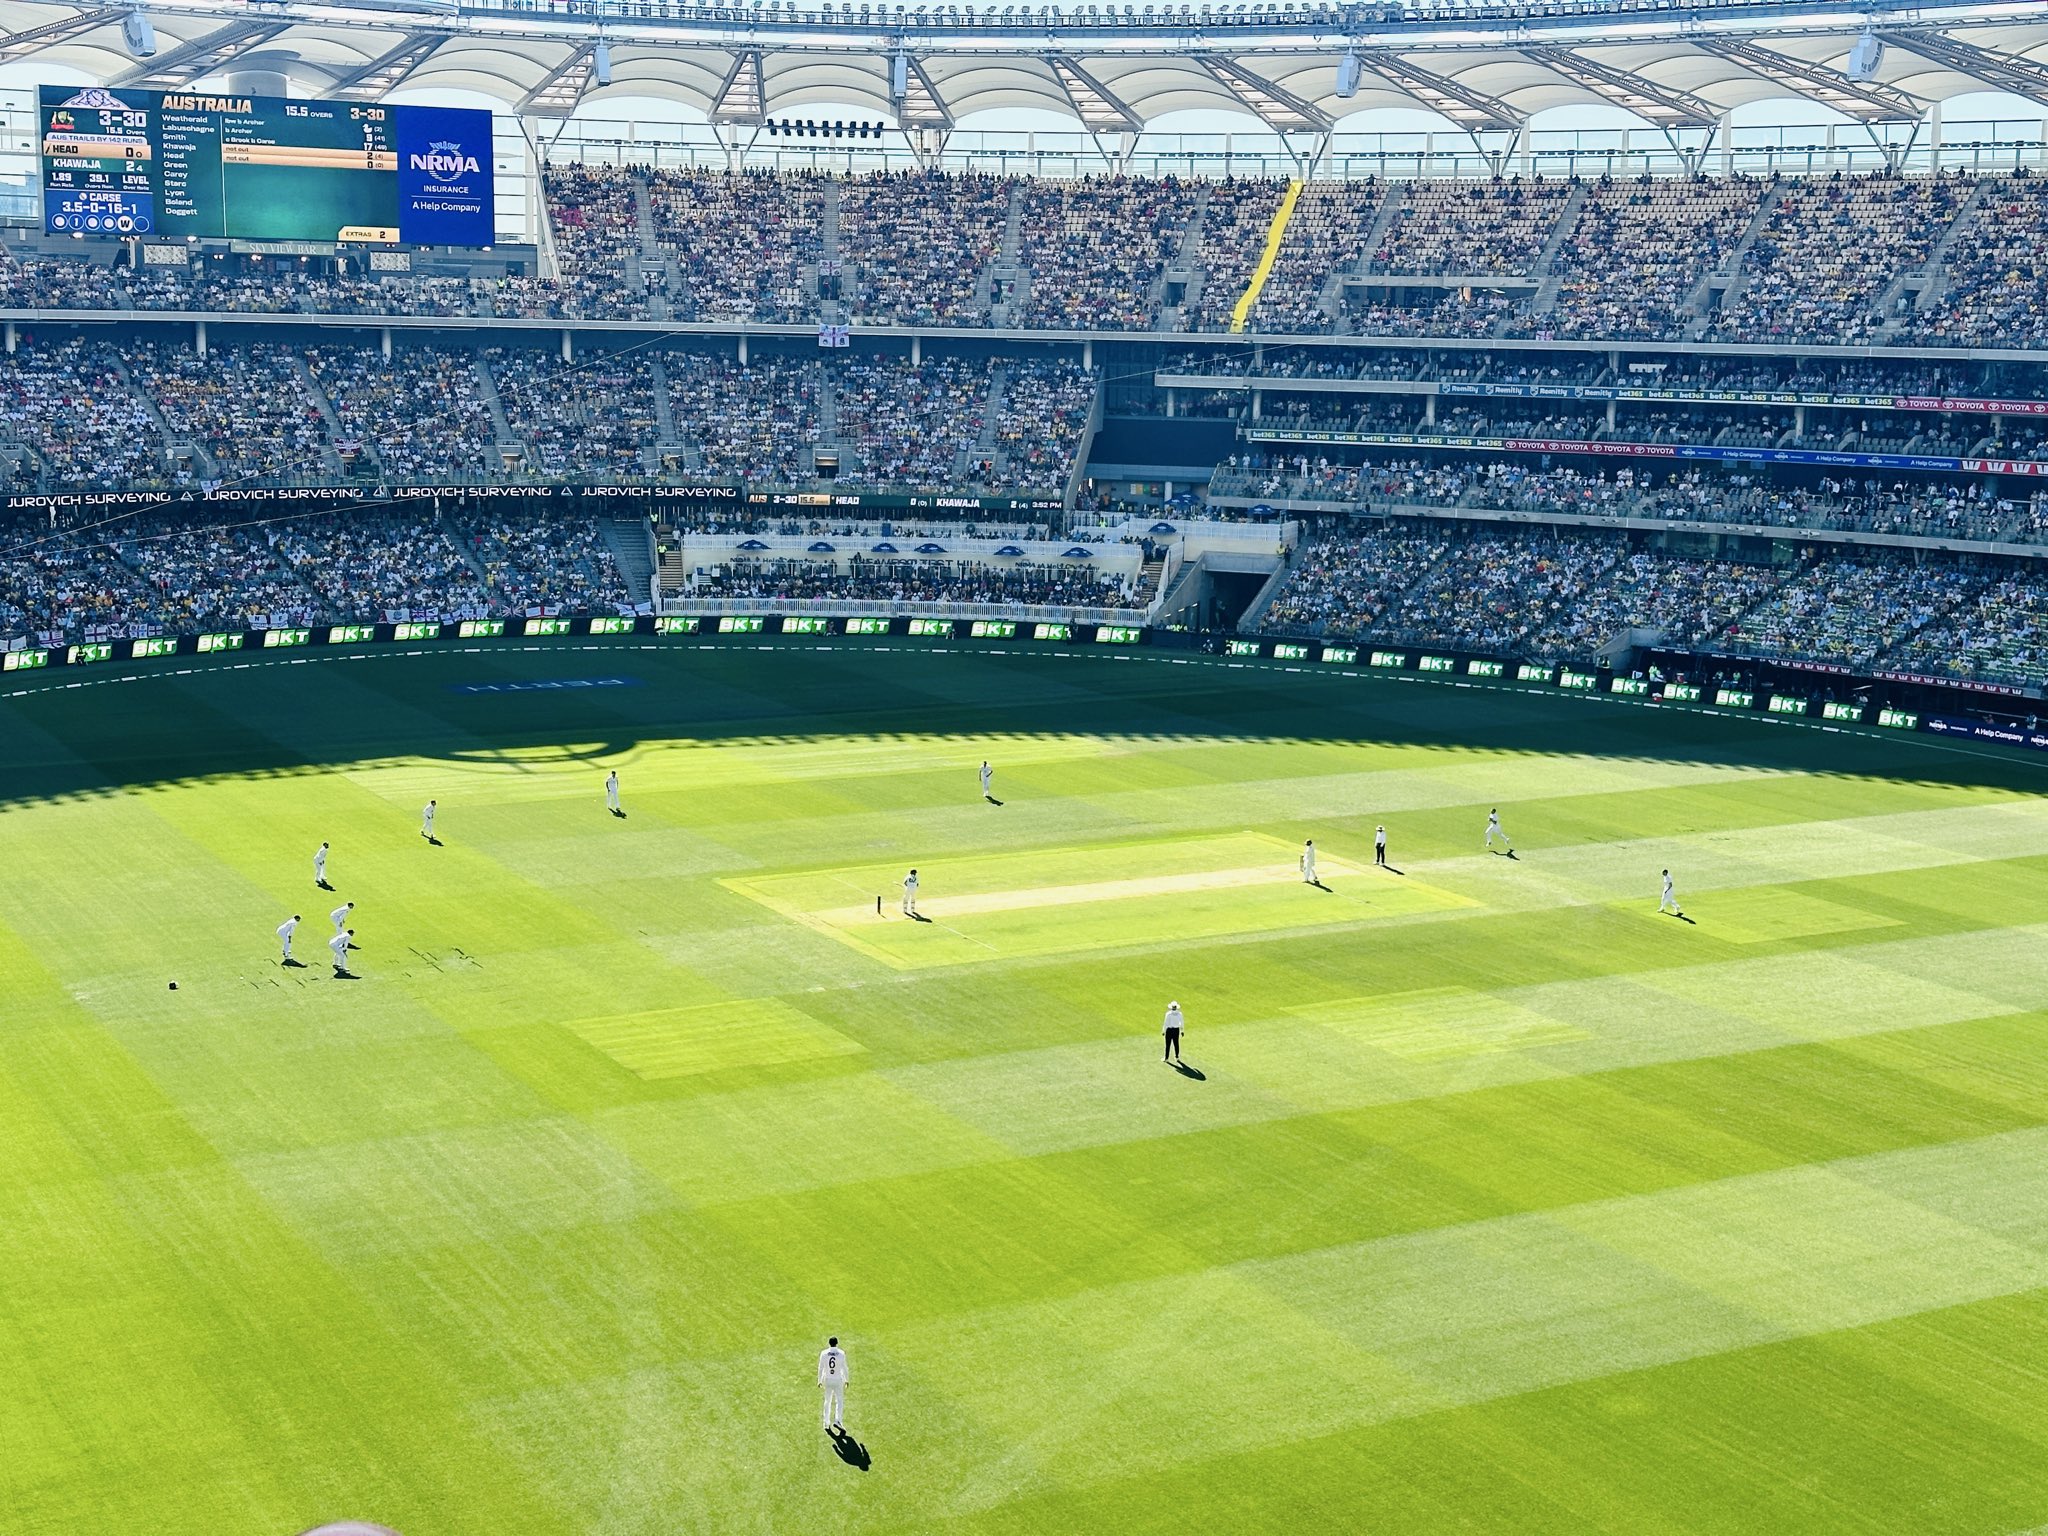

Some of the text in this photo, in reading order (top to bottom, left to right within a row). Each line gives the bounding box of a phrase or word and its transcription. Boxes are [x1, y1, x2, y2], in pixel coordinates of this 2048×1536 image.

[161, 95, 253, 114] AUSTRALIA
[285, 105, 308, 117] 15.5
[350, 107, 385, 121] 3-30
[99, 110, 147, 127] 3-30
[161, 114, 208, 123] Weatherald
[105, 126, 123, 134] 15.5
[162, 124, 215, 133] Labuschagne
[162, 133, 187, 141] Smith
[52, 144, 78, 154] HEAD
[126, 147, 134, 157] 0
[162, 142, 197, 151] Khawaja
[363, 142, 373, 150] 17
[163, 151, 185, 159] Head
[367, 152, 373, 160] 2
[53, 158, 102, 169] KHAWAJA
[126, 160, 134, 172] 2
[163, 161, 188, 169] Green
[410, 154, 480, 173] NRMA
[52, 172, 149, 185] 1.89 39.1 LEVEL
[164, 170, 188, 179] Carey
[164, 179, 187, 187] Starc
[423, 184, 469, 194] INSURANCE
[89, 192, 121, 203] CARSE
[165, 189, 185, 197] Lyon
[165, 198, 193, 206] Boland
[412, 201, 481, 213] A Help Company
[165, 207, 198, 216] Doggett
[120, 219, 130, 228] W
[379, 230, 386, 239] 2
[249, 243, 317, 254] SKY VIEW BAR
[1451, 385, 1479, 394] Remitly
[1495, 386, 1523, 395] Remitly
[1539, 387, 1568, 397] Remitly
[1584, 388, 1612, 398] Remitly
[1909, 400, 1938, 408] TOYOTA
[1955, 402, 1984, 410] TOYOTA
[2000, 403, 2030, 412] TOYOTA
[1517, 441, 1545, 449] TOYOTA
[1560, 443, 1588, 451] TOYOTA
[1603, 445, 1631, 453] TOYOTA
[1646, 447, 1675, 455] TOYOTA
[1739, 451, 1763, 459] Company
[1928, 460, 1953, 468] Company
[203, 488, 364, 501] JUROVICH SURVEYING
[393, 486, 552, 498] JUROVICH SURVEYING
[581, 486, 736, 498] JUROVICH SURVEYING
[7, 492, 171, 508] JUROVICH SURVEYING
[749, 495, 768, 503] AUS
[773, 495, 798, 504] 3-30
[800, 496, 815, 504] 15.5
[835, 496, 860, 505] HEAD
[936, 497, 1028, 510] KHAWAJA 2 (4)
[459, 620, 504, 638] BKT
[524, 618, 570, 636] BKT
[590, 617, 636, 634] BKT
[718, 617, 764, 633] BKT
[845, 618, 890, 634] BKT
[908, 619, 953, 635] BKT
[971, 621, 1016, 637] BKT
[329, 626, 375, 644] BKT
[394, 623, 440, 640] BKT
[1096, 626, 1142, 643] BKT
[197, 632, 244, 652] BKT
[264, 629, 310, 648] BKT
[132, 637, 178, 658] BKT
[1274, 644, 1308, 660] BKT
[3, 650, 49, 671] BKT
[1322, 648, 1357, 663] BKT
[1419, 656, 1454, 672] BKT
[1517, 665, 1552, 682] BKT
[1560, 673, 1597, 689] BKT
[1611, 677, 1649, 695] BKT
[1663, 683, 1700, 701] BKT
[1715, 690, 1753, 707] BKT
[1768, 696, 1807, 715] BKT
[1822, 703, 1862, 722] BKT
[1878, 709, 1918, 729] BKT
[1980, 728, 1995, 738] Help
[1995, 730, 2024, 742] Company
[829, 1356, 836, 1369] 6
